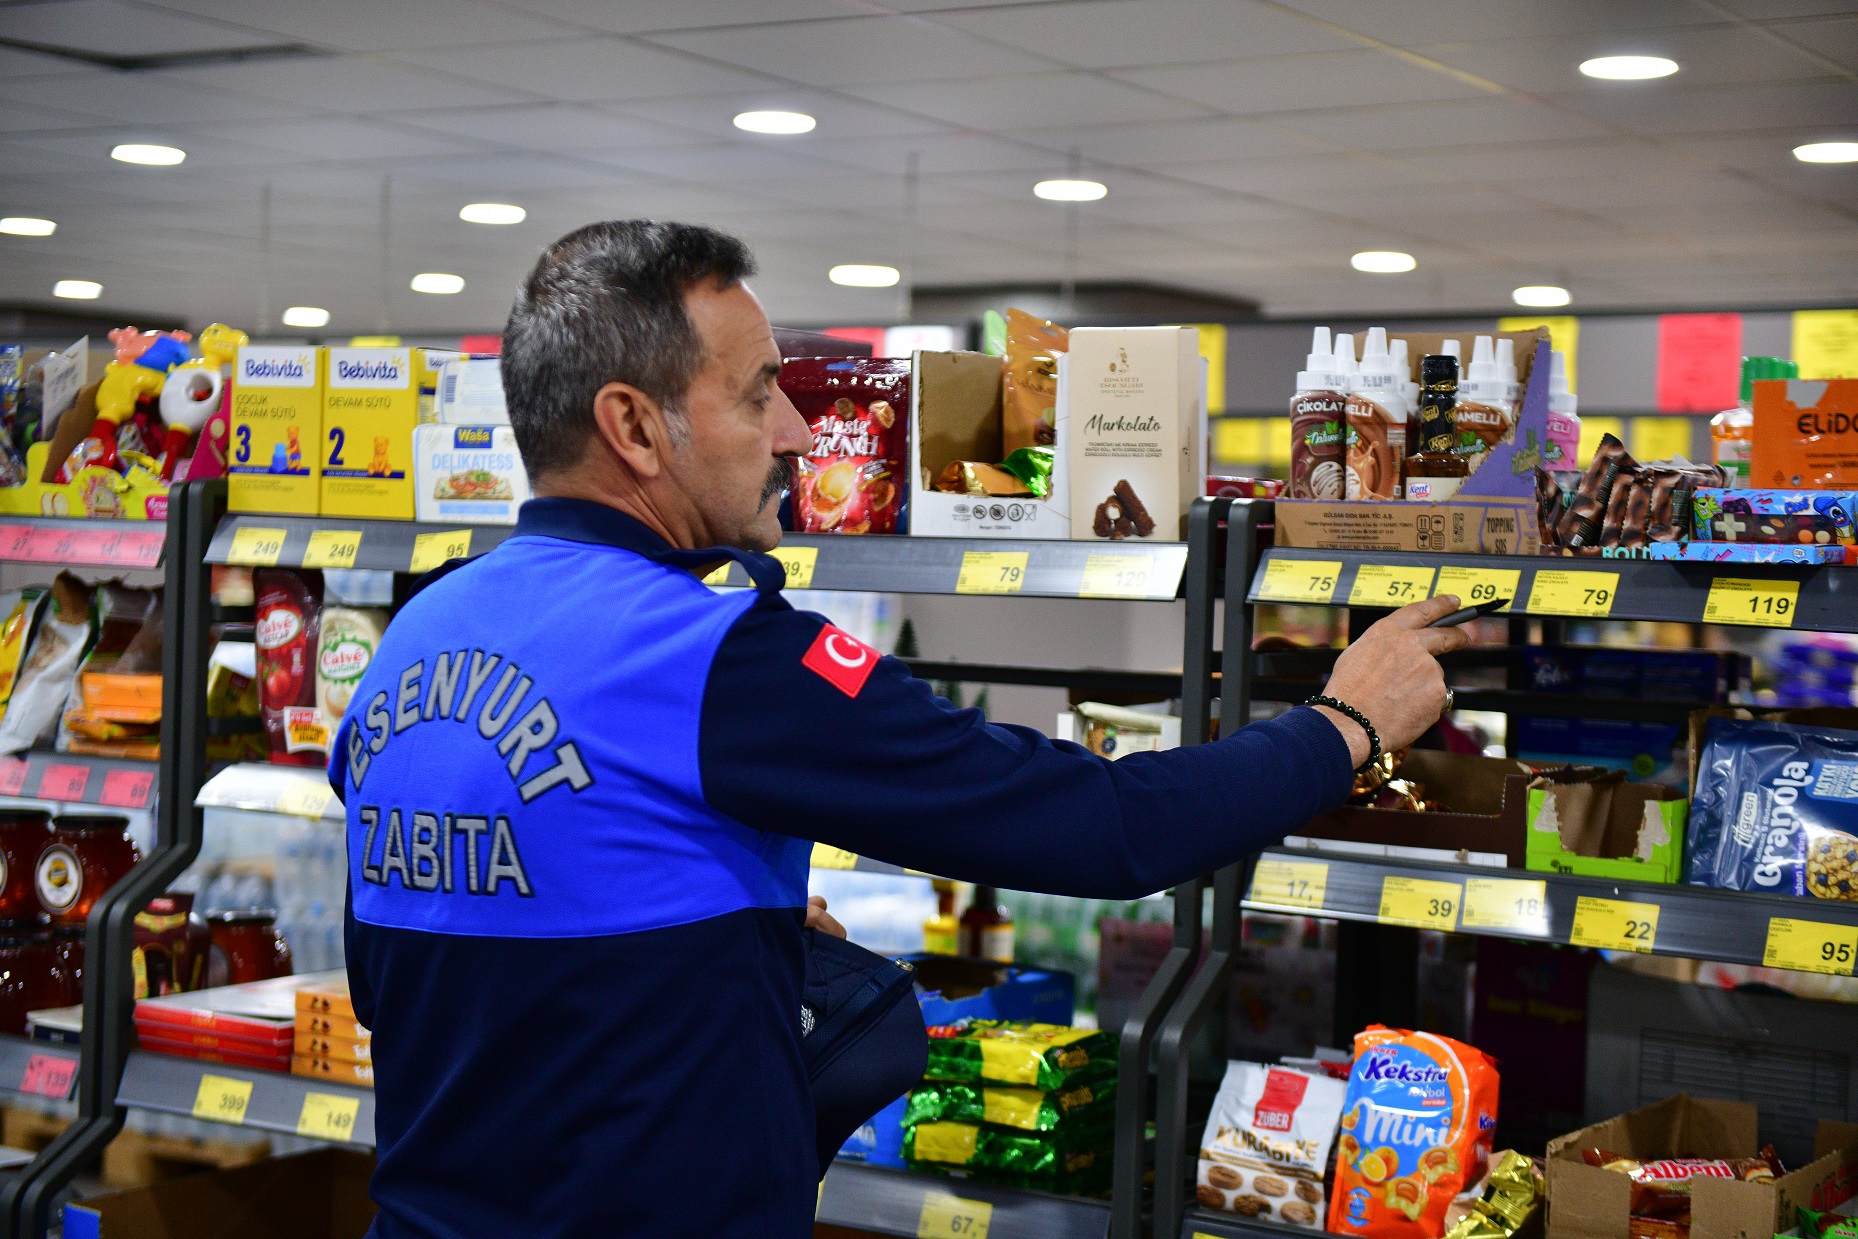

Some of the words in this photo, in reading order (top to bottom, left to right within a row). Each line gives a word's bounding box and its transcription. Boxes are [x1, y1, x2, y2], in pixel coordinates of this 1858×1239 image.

[245, 358, 304, 378] Bebivita
[338, 360, 399, 380] Bebivita
[328, 396, 363, 409] DEVAM
[365, 395, 392, 409] SÜTÜ
[236, 407, 267, 418] DEVAM
[270, 406, 296, 419] SÜTÜ
[1084, 413, 1163, 437] Markolato
[235, 424, 251, 463] 3
[328, 427, 345, 466] 2
[432, 453, 514, 471] DELIKATESS
[1409, 484, 1429, 494] Kent
[1486, 517, 1515, 534] TOPPING
[254, 541, 279, 555] 249
[329, 543, 355, 558] 249
[446, 544, 465, 557] 95
[1000, 566, 1021, 582] 79
[1115, 571, 1147, 587] 129
[1309, 576, 1333, 592] 75
[1583, 588, 1609, 606] 79
[1749, 595, 1790, 615] 119
[258, 614, 293, 634] Calvé
[323, 647, 363, 666] Calvé
[347, 647, 595, 805] ESENYURT
[1753, 761, 1814, 887] Granola
[360, 804, 536, 899] ZABITA
[1427, 898, 1453, 917] 39
[1515, 897, 1539, 916] 18
[1623, 919, 1652, 941] 22
[1821, 941, 1850, 962] 95
[1364, 1054, 1448, 1083] Kekstra
[219, 1093, 245, 1113] 399
[326, 1110, 352, 1129] 149
[1637, 1159, 1735, 1184] Albeni
